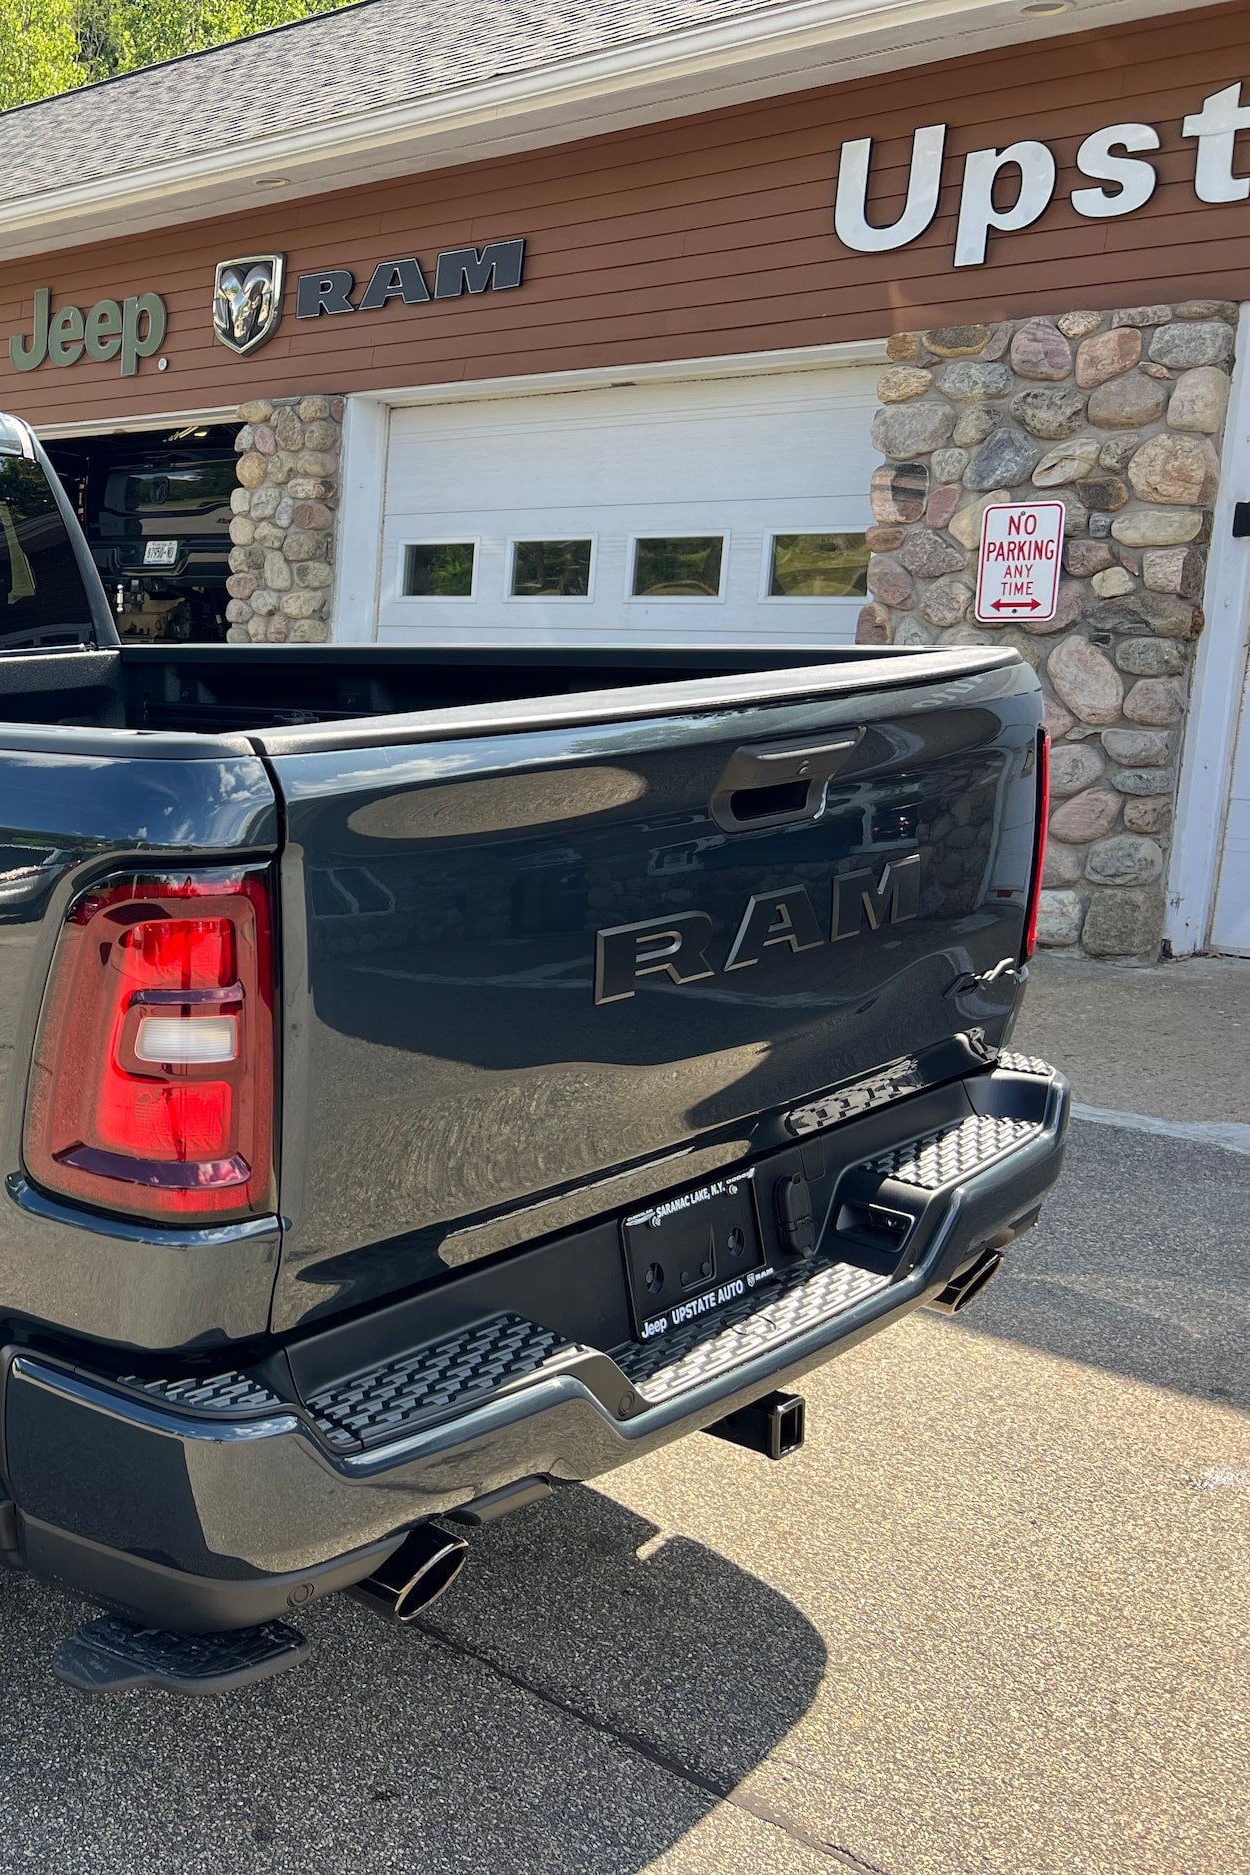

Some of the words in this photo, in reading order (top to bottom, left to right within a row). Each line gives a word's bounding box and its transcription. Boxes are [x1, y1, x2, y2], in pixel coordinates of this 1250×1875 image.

[833, 80, 1250, 268] Upst
[295, 238, 526, 320] RAM
[9, 286, 168, 377] Jeep
[1008, 514, 1037, 536] NO
[986, 539, 1055, 562] PARKING
[1001, 581, 1034, 596] TIME
[1003, 564, 1034, 579] ANY
[593, 853, 921, 1006] RAM
[655, 1195, 690, 1218] SARANAC
[690, 1188, 711, 1205] LAKE,
[710, 1181, 726, 1197] N.Y.
[671, 1292, 717, 1325] UPSTATE
[717, 1279, 744, 1305] AUTO
[641, 1317, 668, 1339] Jeep
